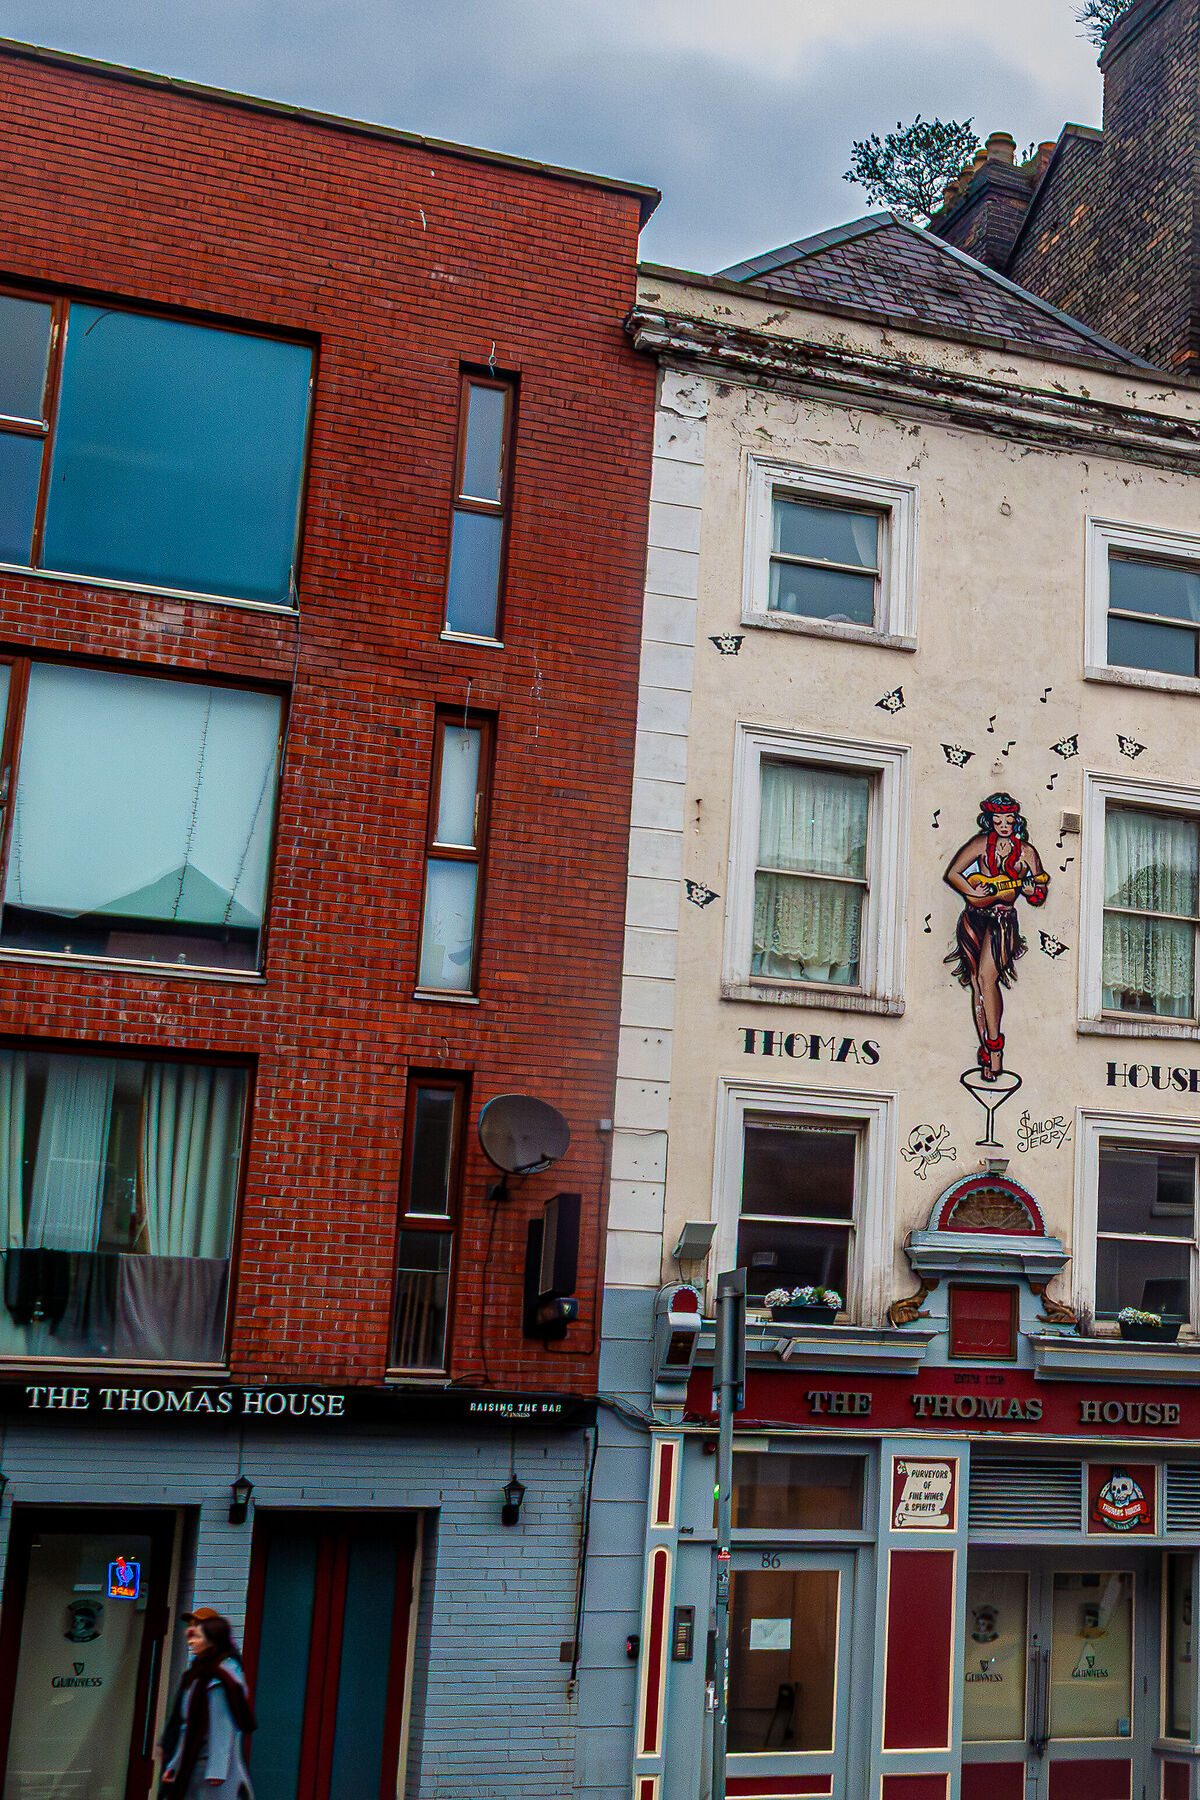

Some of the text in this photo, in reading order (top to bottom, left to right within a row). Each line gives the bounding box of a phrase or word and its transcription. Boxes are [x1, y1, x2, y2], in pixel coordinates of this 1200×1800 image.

[738, 1027, 880, 1065] THOMAS
[1017, 1110, 1066, 1139] SAILOR
[1017, 1121, 1072, 1152] JERRY
[26, 1387, 345, 1416] THE THOMAS HOUSE
[470, 1402, 562, 1413] RAISING THE BAR
[807, 1391, 1181, 1425] THE THOMAS HOUSE
[911, 1469, 948, 1479] PURVEYORS
[923, 1481, 932, 1489] OF
[909, 1491, 944, 1501] FINE WINES
[904, 1503, 936, 1512] & SPIRITS
[761, 1552, 783, 1569] 86
[51, 1676, 103, 1688] GUINNESS
